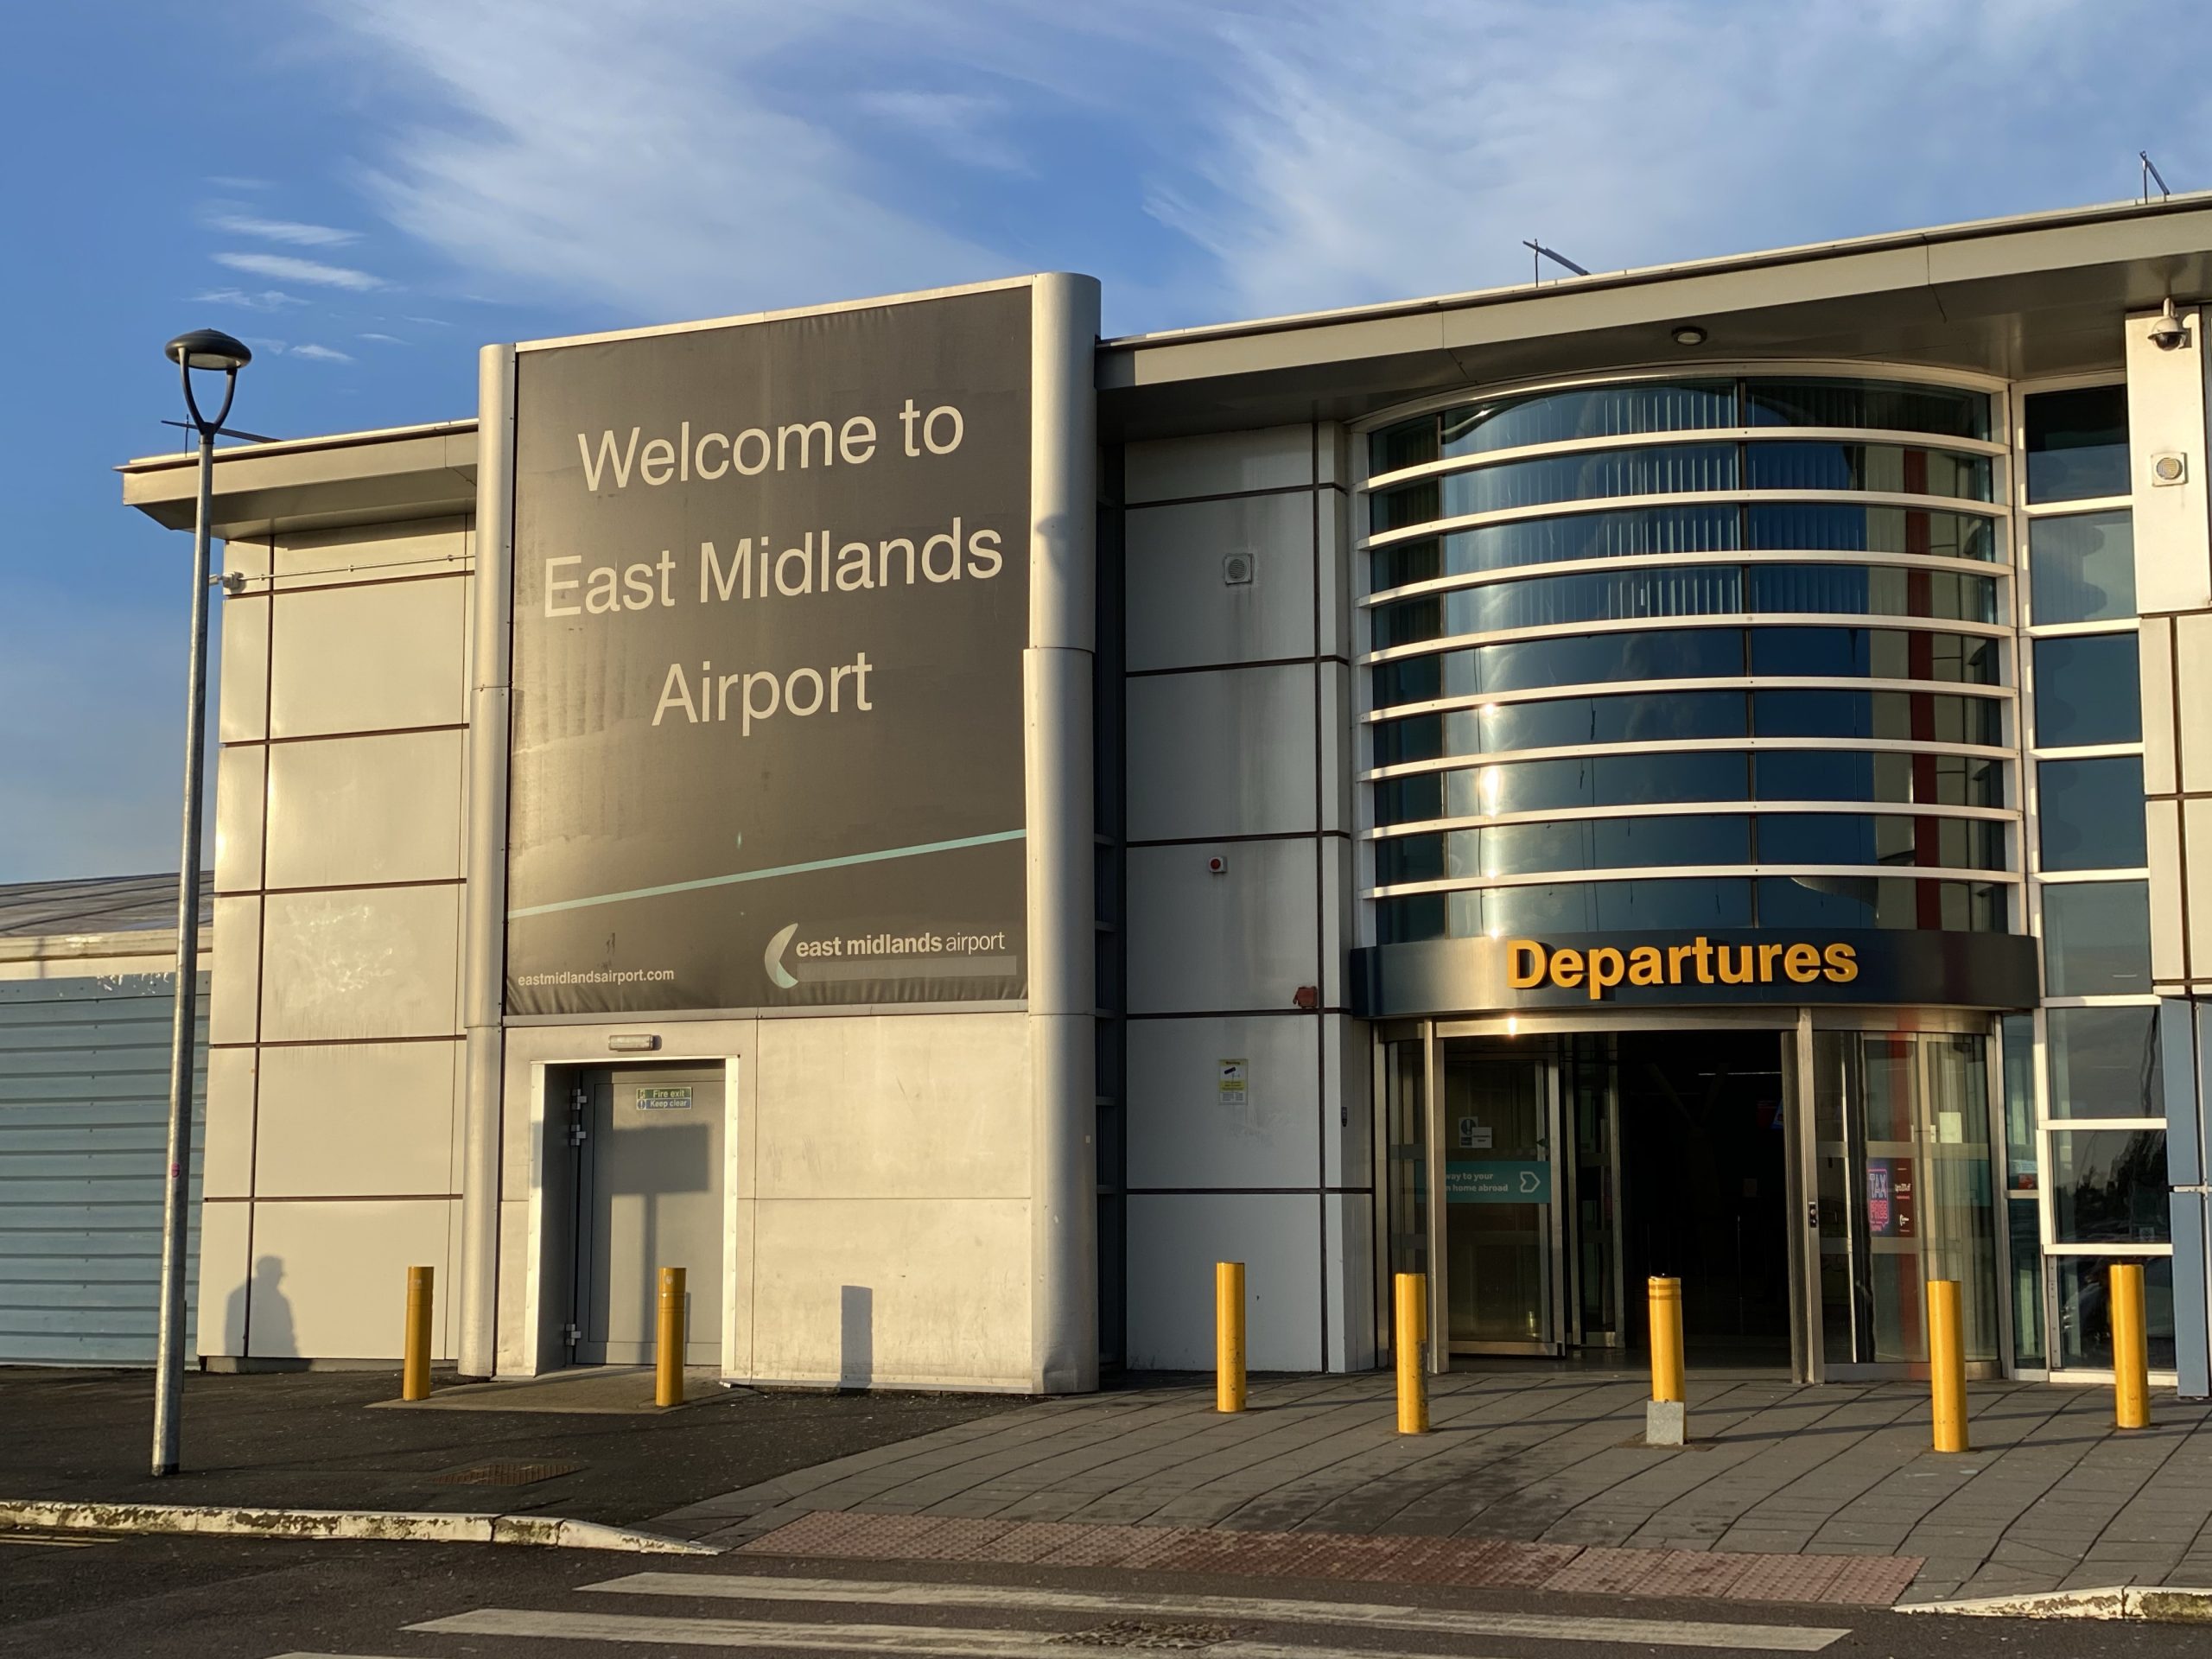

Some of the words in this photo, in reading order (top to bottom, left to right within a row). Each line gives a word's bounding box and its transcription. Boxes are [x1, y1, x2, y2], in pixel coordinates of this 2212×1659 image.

[577, 415, 876, 492] Welcome
[899, 399, 964, 457] to
[544, 550, 677, 617] East
[700, 517, 1003, 603] Midlands
[652, 652, 873, 736] Airport
[796, 937, 842, 957] east
[847, 932, 943, 956] midlands
[945, 931, 1006, 955] airport
[518, 969, 675, 986] eastmidlandsairport.com
[1507, 936, 1859, 1000] Departures
[650, 1099, 668, 1109] Keep
[671, 1089, 684, 1097] exit
[1452, 1184, 1477, 1192] home
[1478, 1184, 1509, 1192] abroad
[1463, 1172, 1472, 1180] to
[1869, 1173, 1886, 1198] TAX
